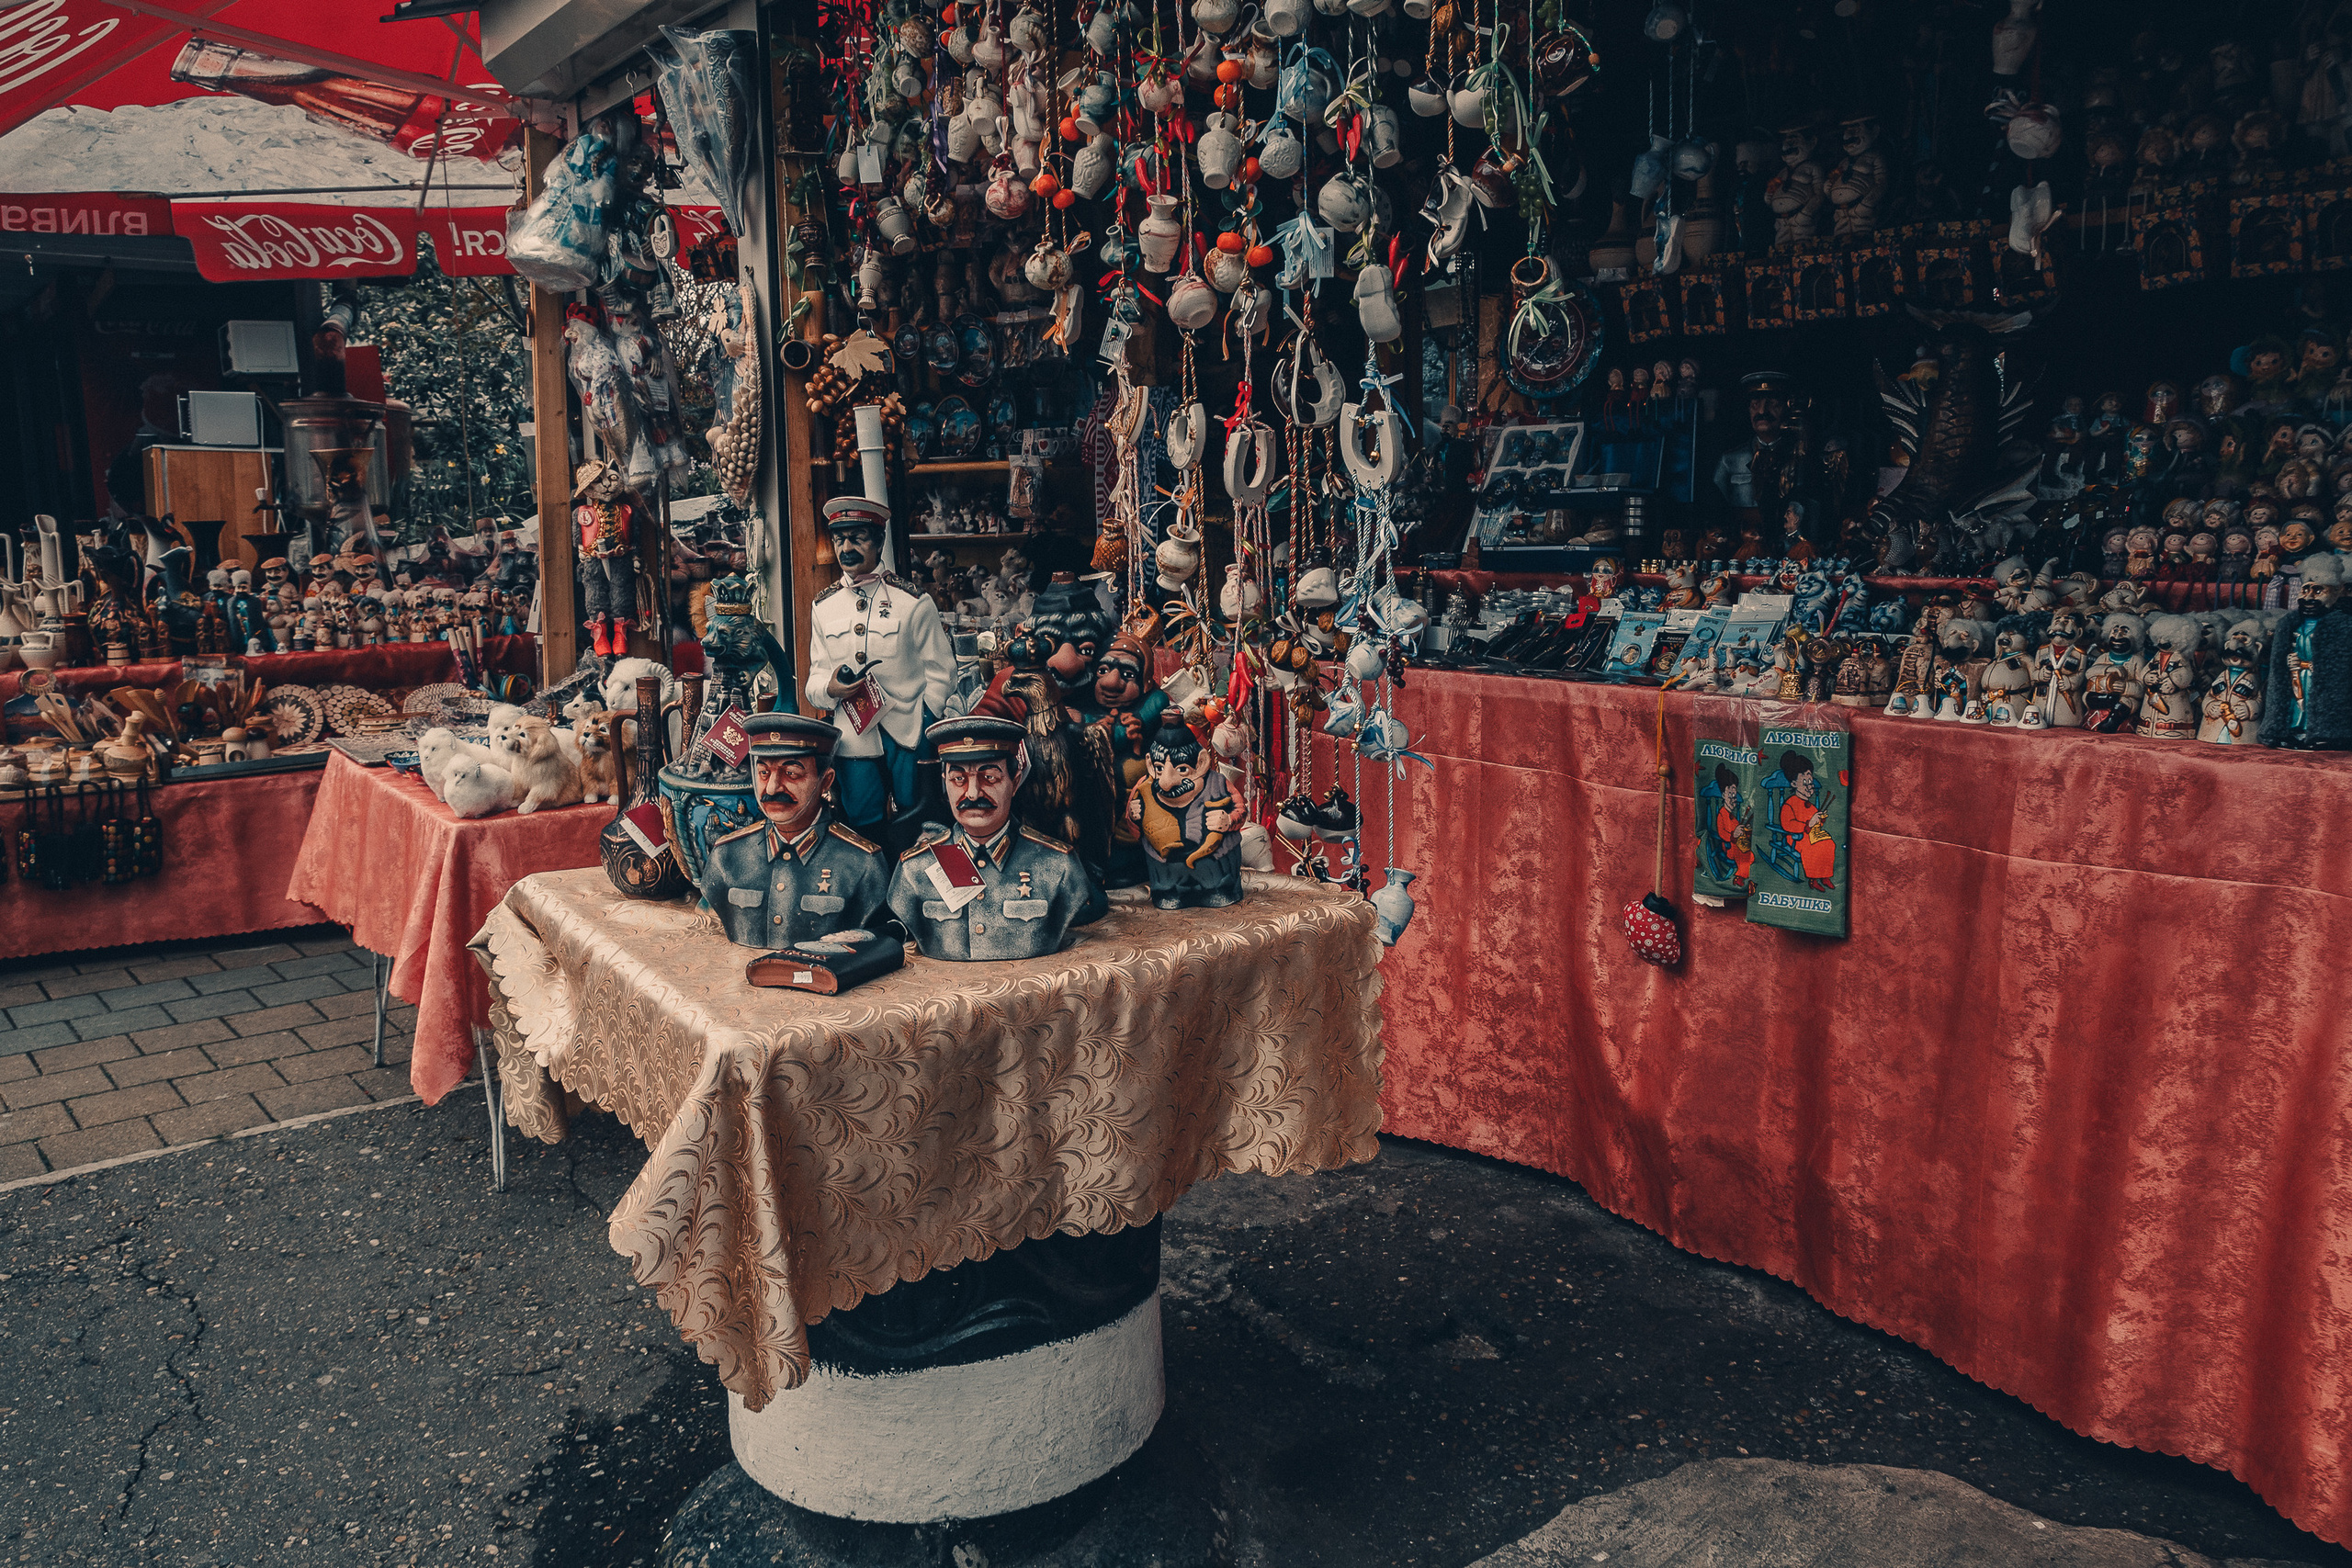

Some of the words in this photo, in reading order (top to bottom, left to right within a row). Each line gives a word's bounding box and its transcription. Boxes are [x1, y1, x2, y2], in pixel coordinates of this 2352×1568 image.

[1764, 731, 1840, 748] ЛЮБИМОЙ
[1701, 744, 1758, 765] ЛЮБИМО
[1758, 892, 1832, 913] БАБУШКЕ
